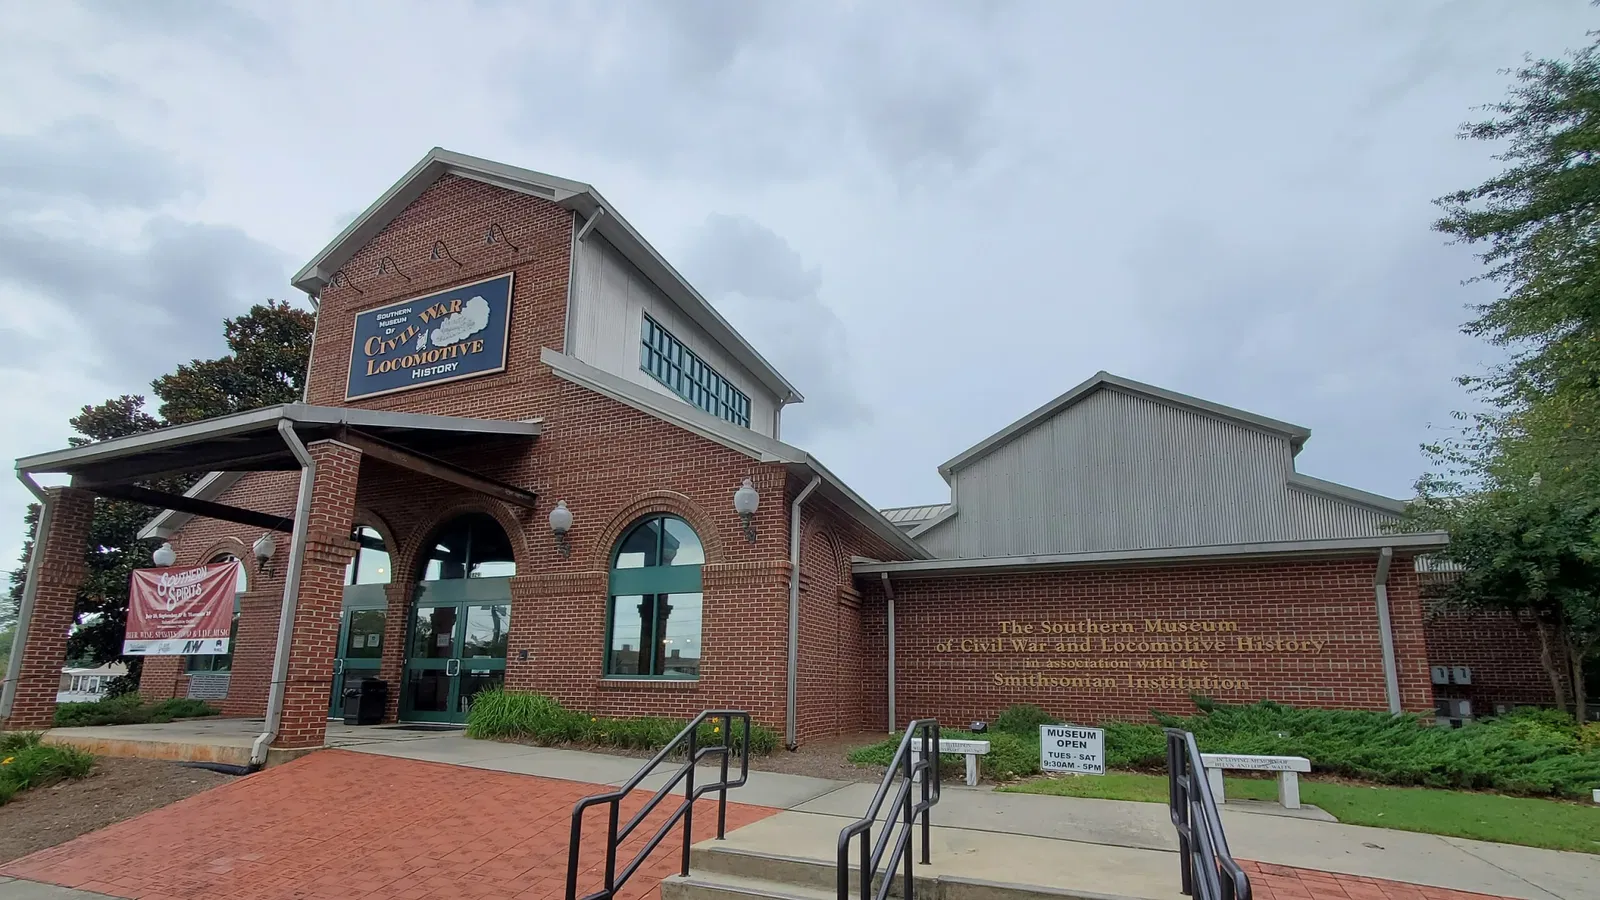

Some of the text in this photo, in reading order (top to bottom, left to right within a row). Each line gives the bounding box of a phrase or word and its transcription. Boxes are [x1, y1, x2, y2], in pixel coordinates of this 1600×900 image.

[376, 307, 412, 321] SOUTHERN
[364, 323, 420, 357] CIVIL
[418, 299, 462, 324] WAR
[379, 316, 407, 328] MUSEUM
[385, 327, 396, 335] OF
[365, 339, 485, 377] LOCOMOTIVE
[411, 362, 458, 379] HISTORY
[157, 566, 208, 597] SOUTHERN
[167, 583, 202, 611] SPIRITS
[999, 619, 1238, 634] The Southern Museum
[936, 636, 1328, 655] of Civil War and Locomotive History
[1025, 657, 1209, 669] in association with the
[994, 672, 1251, 690] Smithsonian Institution
[1047, 729, 1097, 740] MUSEUM
[1057, 739, 1087, 748] OPEN
[1048, 751, 1071, 759] TUES
[1079, 753, 1096, 761] SAT
[1043, 760, 1075, 769] 9:30AM
[1083, 763, 1101, 771] 5PM
